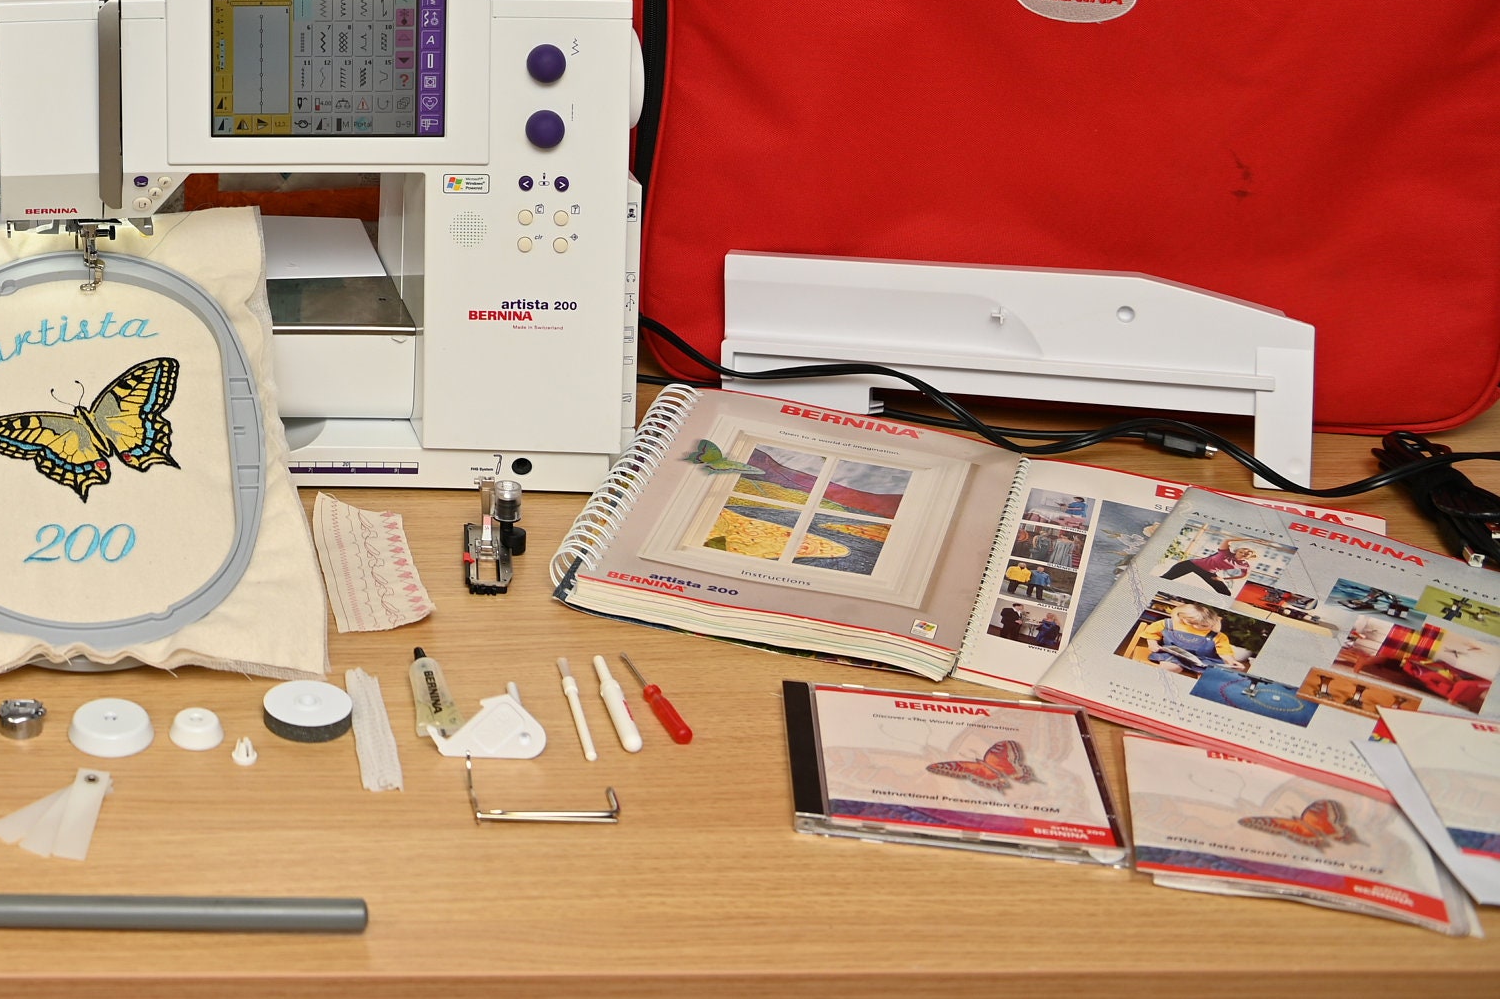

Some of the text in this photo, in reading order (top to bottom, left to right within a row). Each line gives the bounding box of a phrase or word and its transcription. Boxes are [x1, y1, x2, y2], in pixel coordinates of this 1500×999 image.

[468, 310, 533, 321] BERNINA
[501, 299, 577, 311] artista 200
[780, 404, 919, 439] BERNINA
[23, 523, 136, 563] 200
[1192, 511, 1284, 538] Accessories
[1310, 542, 1406, 572] Accessoires
[1288, 522, 1424, 567] BERNINA
[607, 571, 685, 593] BERNINA
[649, 573, 739, 596] artista 200
[741, 570, 811, 586] Instructions
[423, 670, 443, 715] BERNINA
[894, 700, 990, 717] BERNINA
[872, 789, 1060, 813] Instructional Presentation CD-ROM
[1033, 827, 1089, 840] BERNINA
